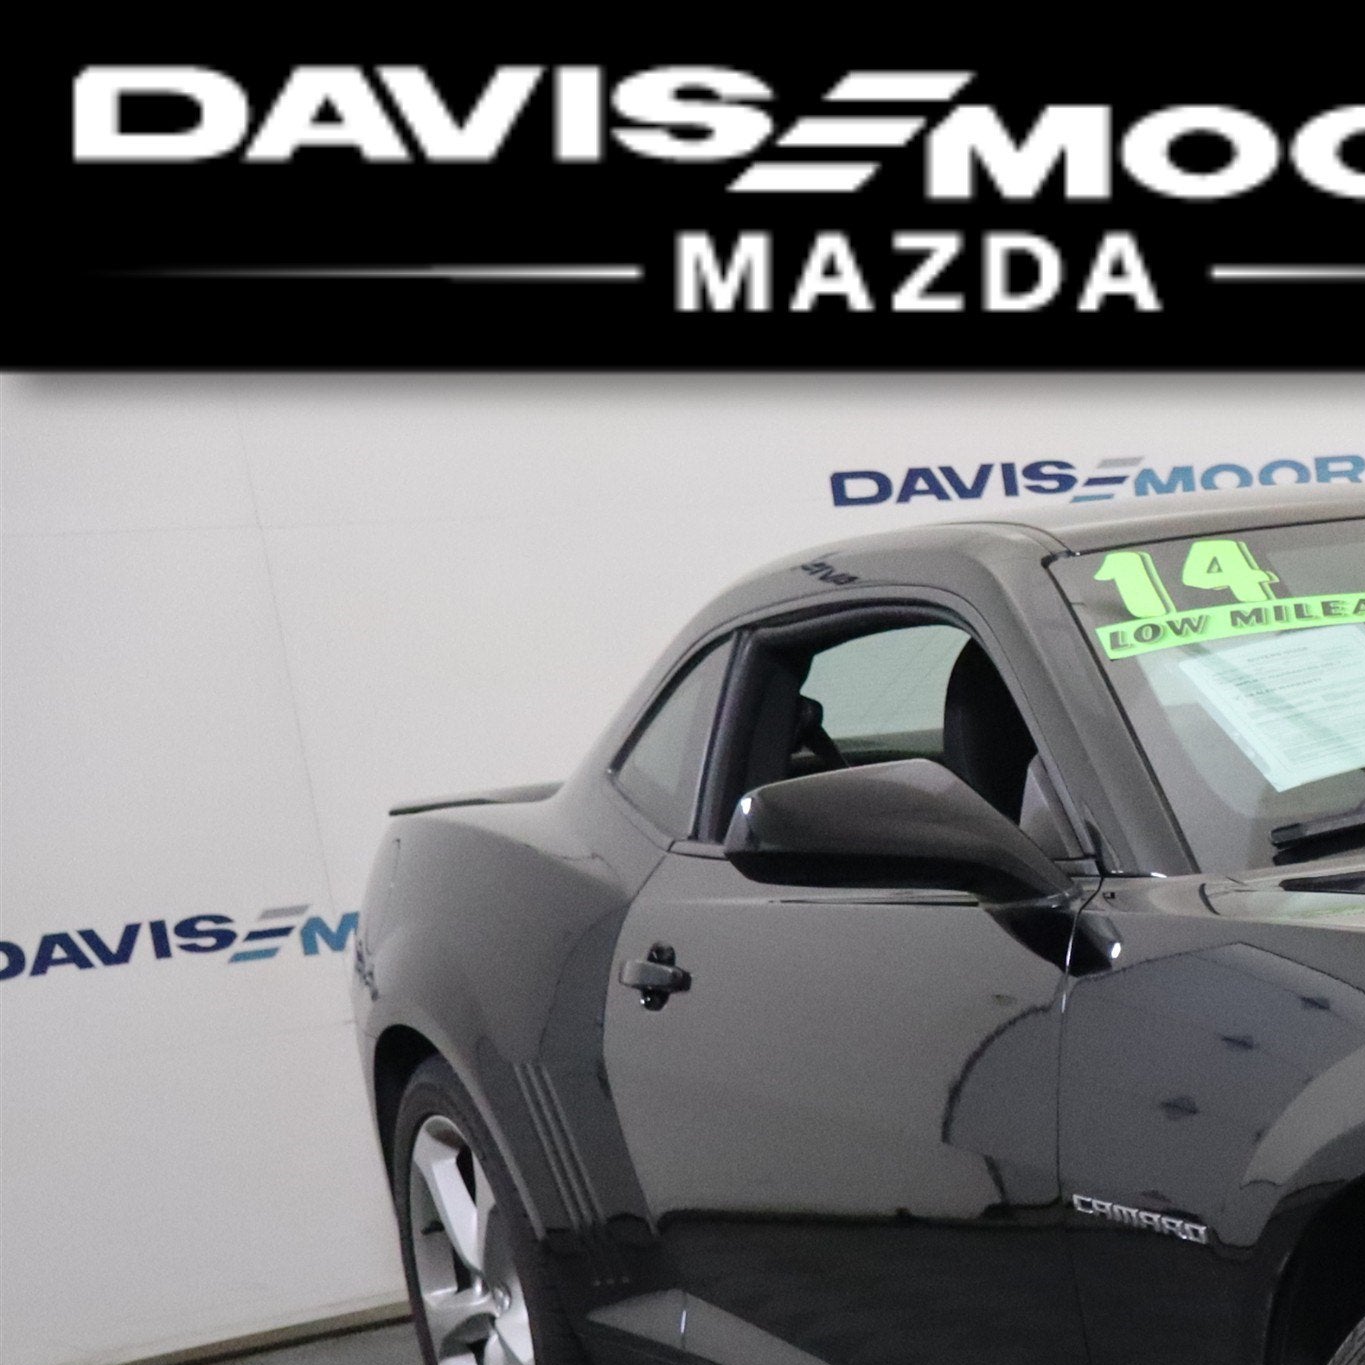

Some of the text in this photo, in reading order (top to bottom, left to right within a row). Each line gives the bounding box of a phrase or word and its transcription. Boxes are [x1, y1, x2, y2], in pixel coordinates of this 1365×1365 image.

[830, 460, 1077, 507] DAVIS
[1093, 538, 1280, 619] 14
[1108, 614, 1209, 652] LOW
[1072, 1193, 1208, 1245] CAMARO
